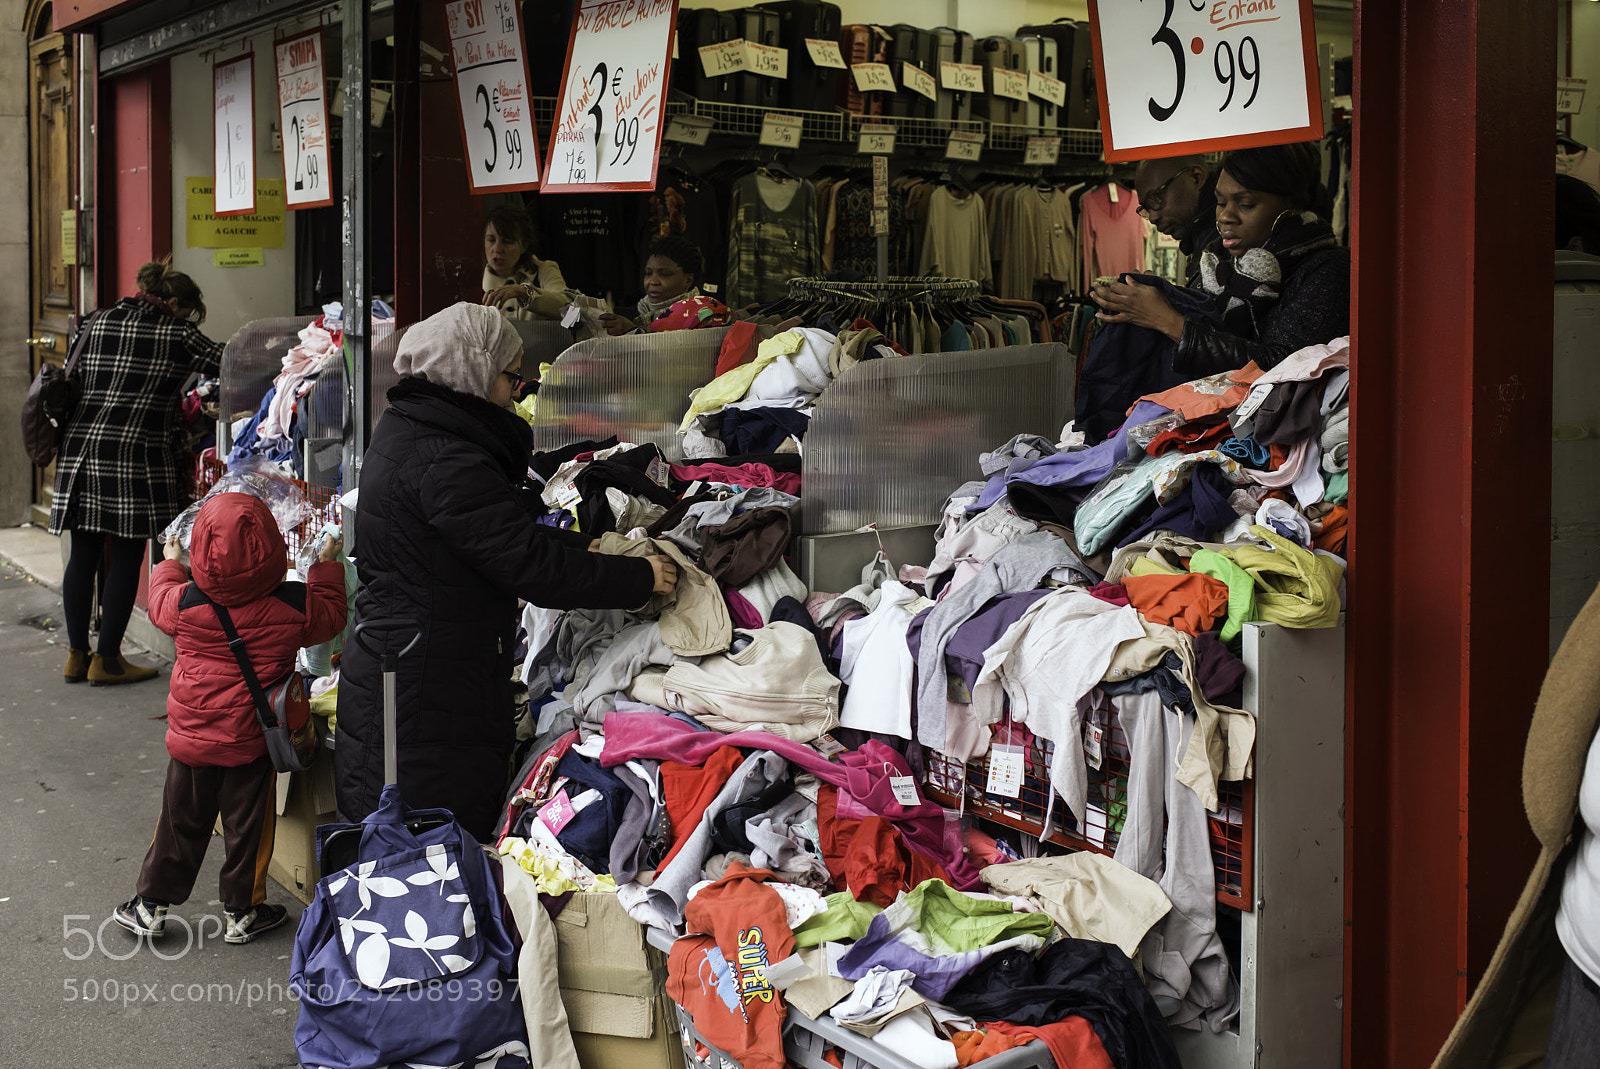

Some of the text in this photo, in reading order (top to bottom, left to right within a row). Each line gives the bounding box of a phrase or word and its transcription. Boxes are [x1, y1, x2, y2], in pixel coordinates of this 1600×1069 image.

[1214, 36, 1260, 112] 99
[476, 84, 497, 173] 3
[505, 128, 522, 170] 99
[557, 131, 585, 144] PARKA
[610, 117, 639, 166] 99
[307, 154, 318, 189] 99
